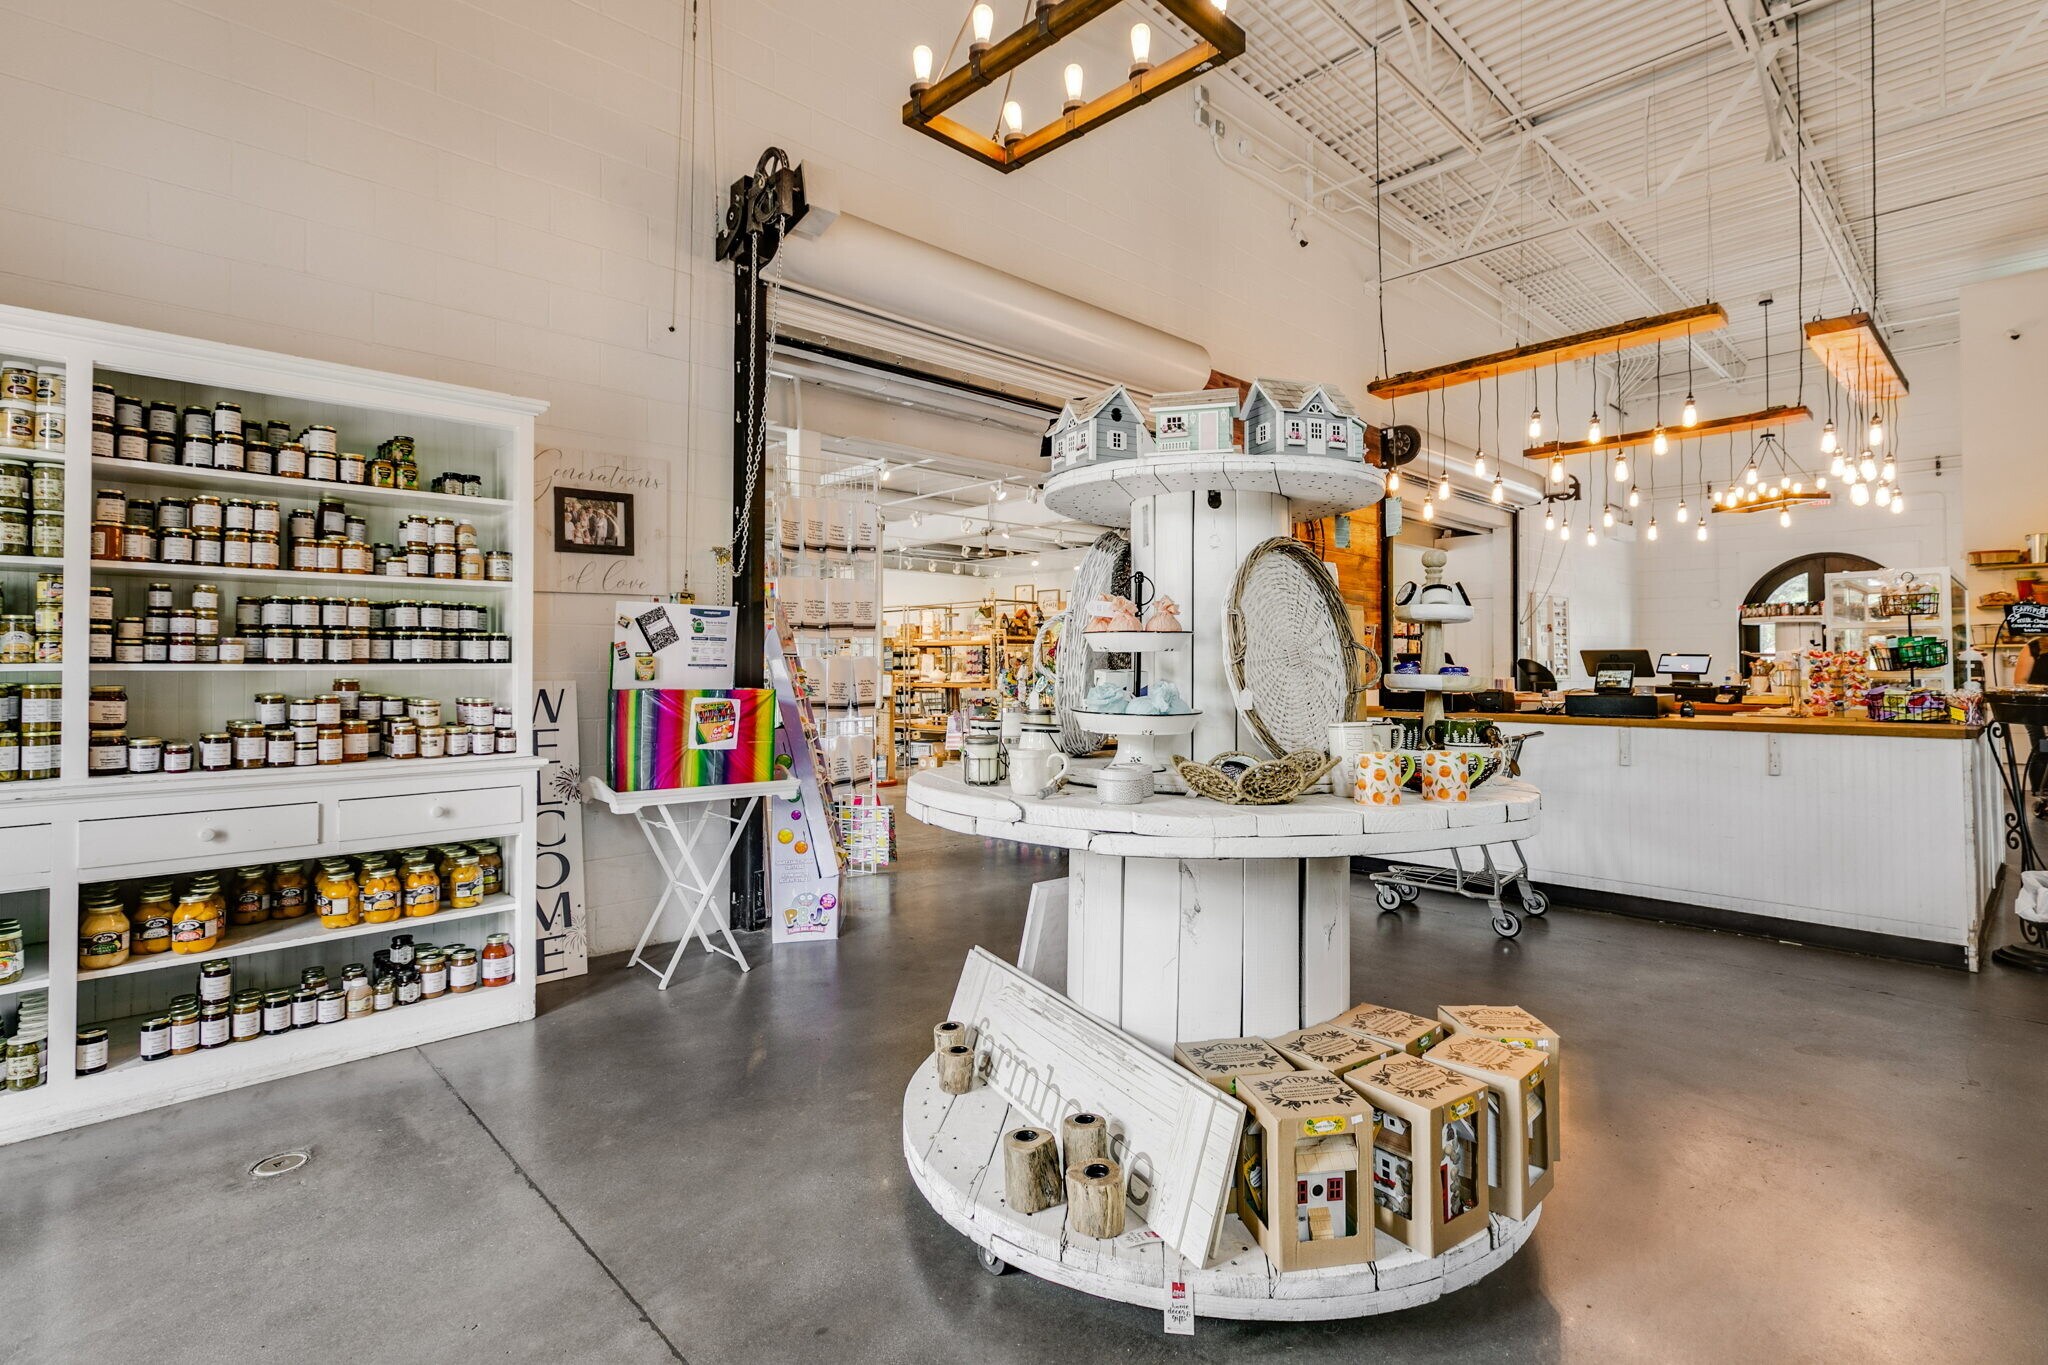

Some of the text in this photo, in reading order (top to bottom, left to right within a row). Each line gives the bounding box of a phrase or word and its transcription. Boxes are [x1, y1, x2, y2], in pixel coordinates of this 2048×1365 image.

[561, 560, 649, 592] of love
[533, 688, 572, 977] WELCOME
